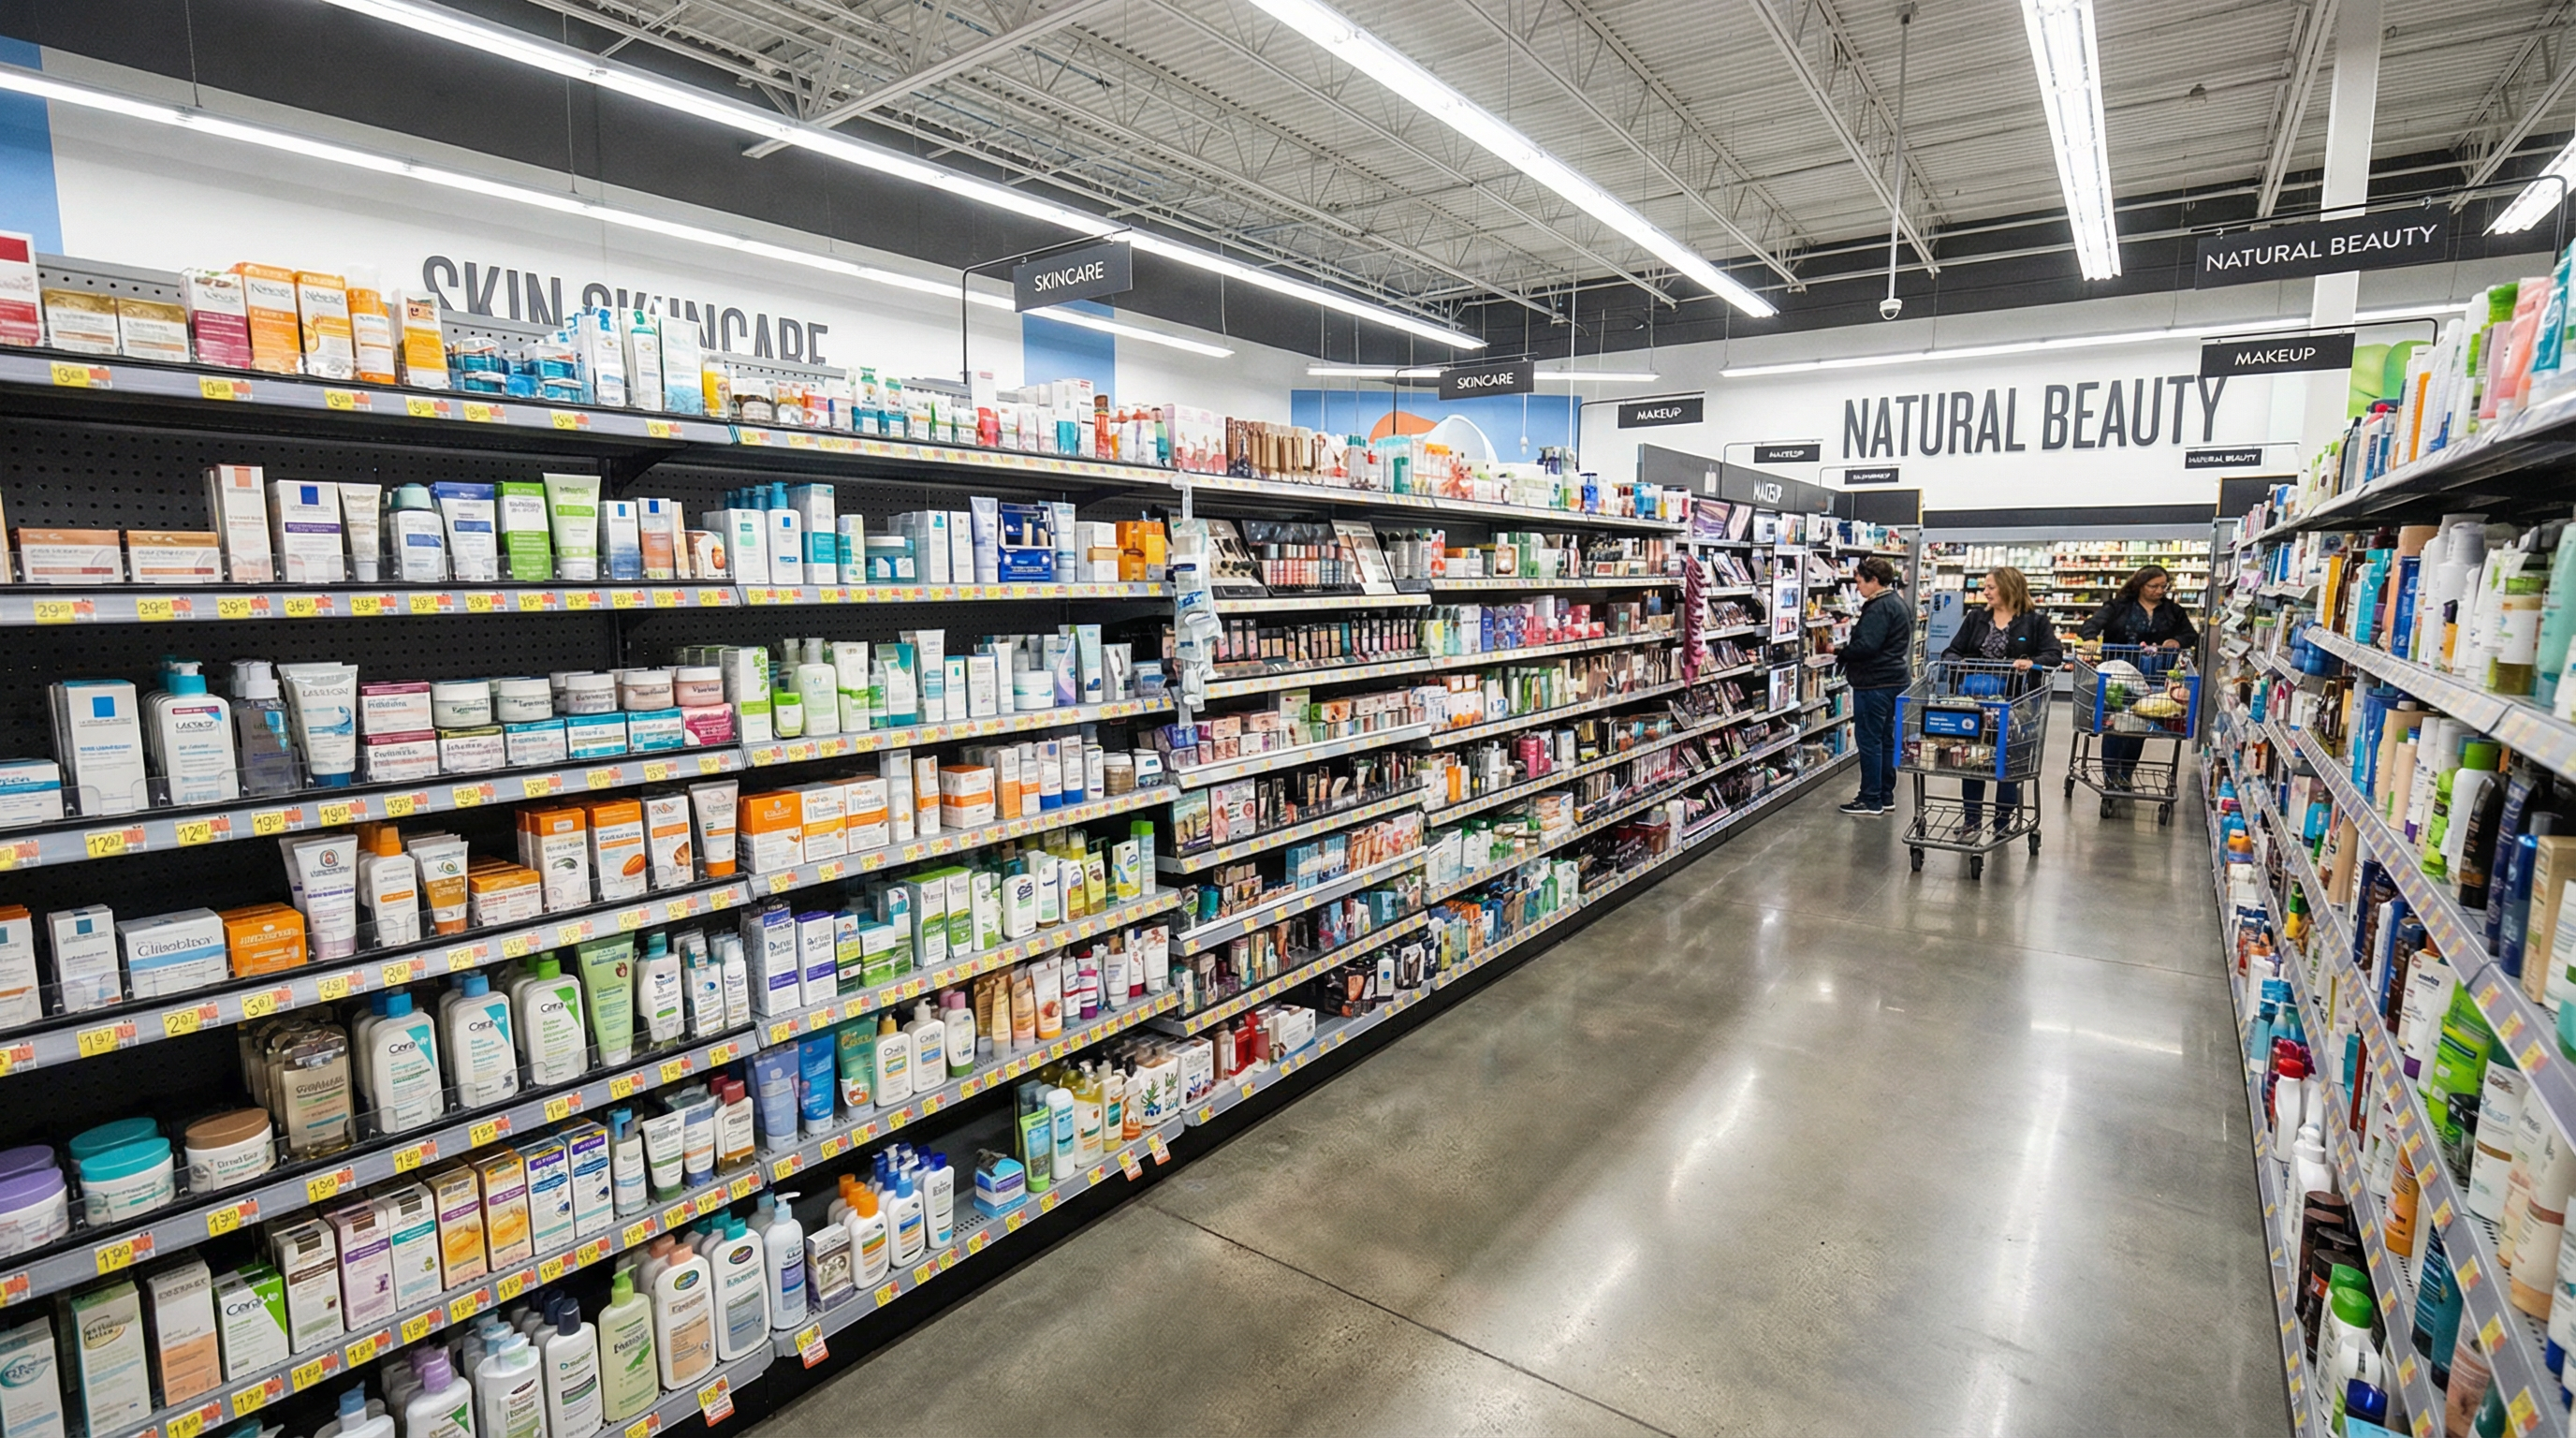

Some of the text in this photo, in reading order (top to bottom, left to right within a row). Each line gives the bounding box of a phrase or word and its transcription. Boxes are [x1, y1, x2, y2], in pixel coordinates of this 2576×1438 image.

[2206, 224, 2437, 271] NATURAL BEAUTY
[1034, 261, 1105, 292] SKINCARE
[2234, 347, 2316, 366] MAKEUP
[1842, 375, 2228, 459] NATURAL BEAUTY
